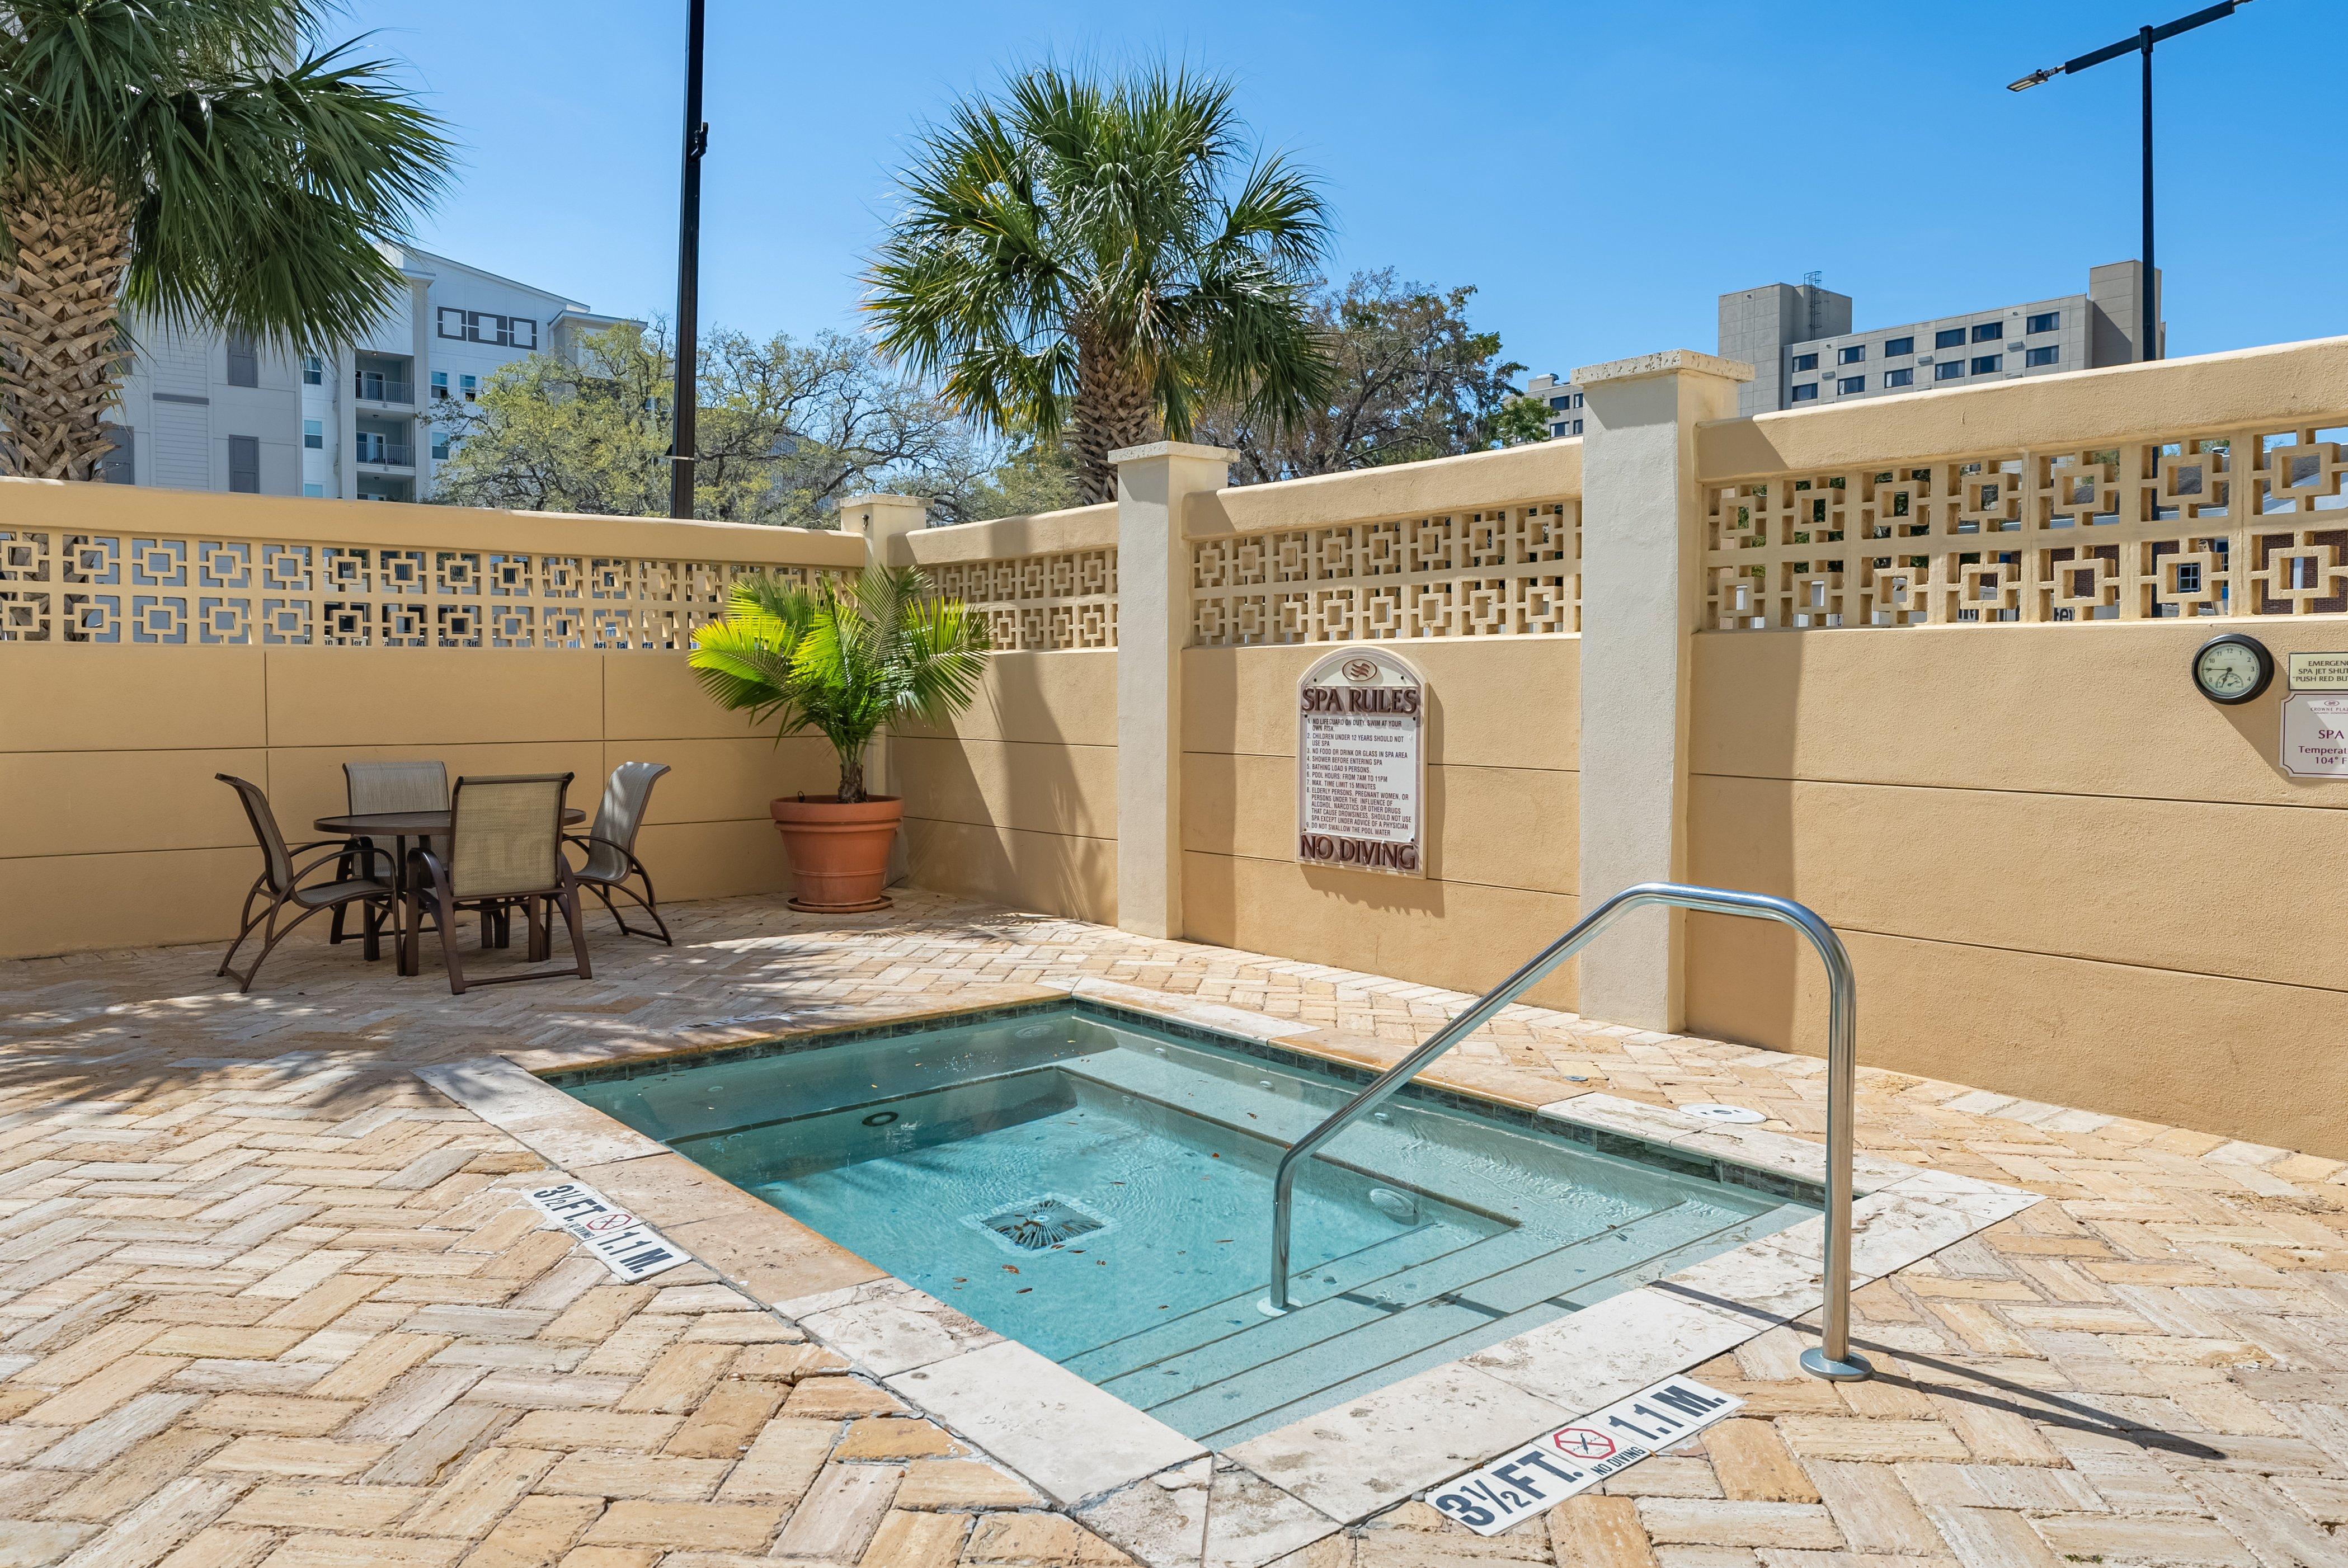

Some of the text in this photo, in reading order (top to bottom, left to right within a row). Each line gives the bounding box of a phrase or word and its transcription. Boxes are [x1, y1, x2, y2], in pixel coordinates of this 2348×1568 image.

[1302, 688, 1417, 714] SPA RULES
[2318, 730, 2344, 739] SPA
[1301, 834, 1414, 869] NO DIVING
[1591, 1459, 1612, 1475] NO
[1611, 1447, 1645, 1470] DIVING
